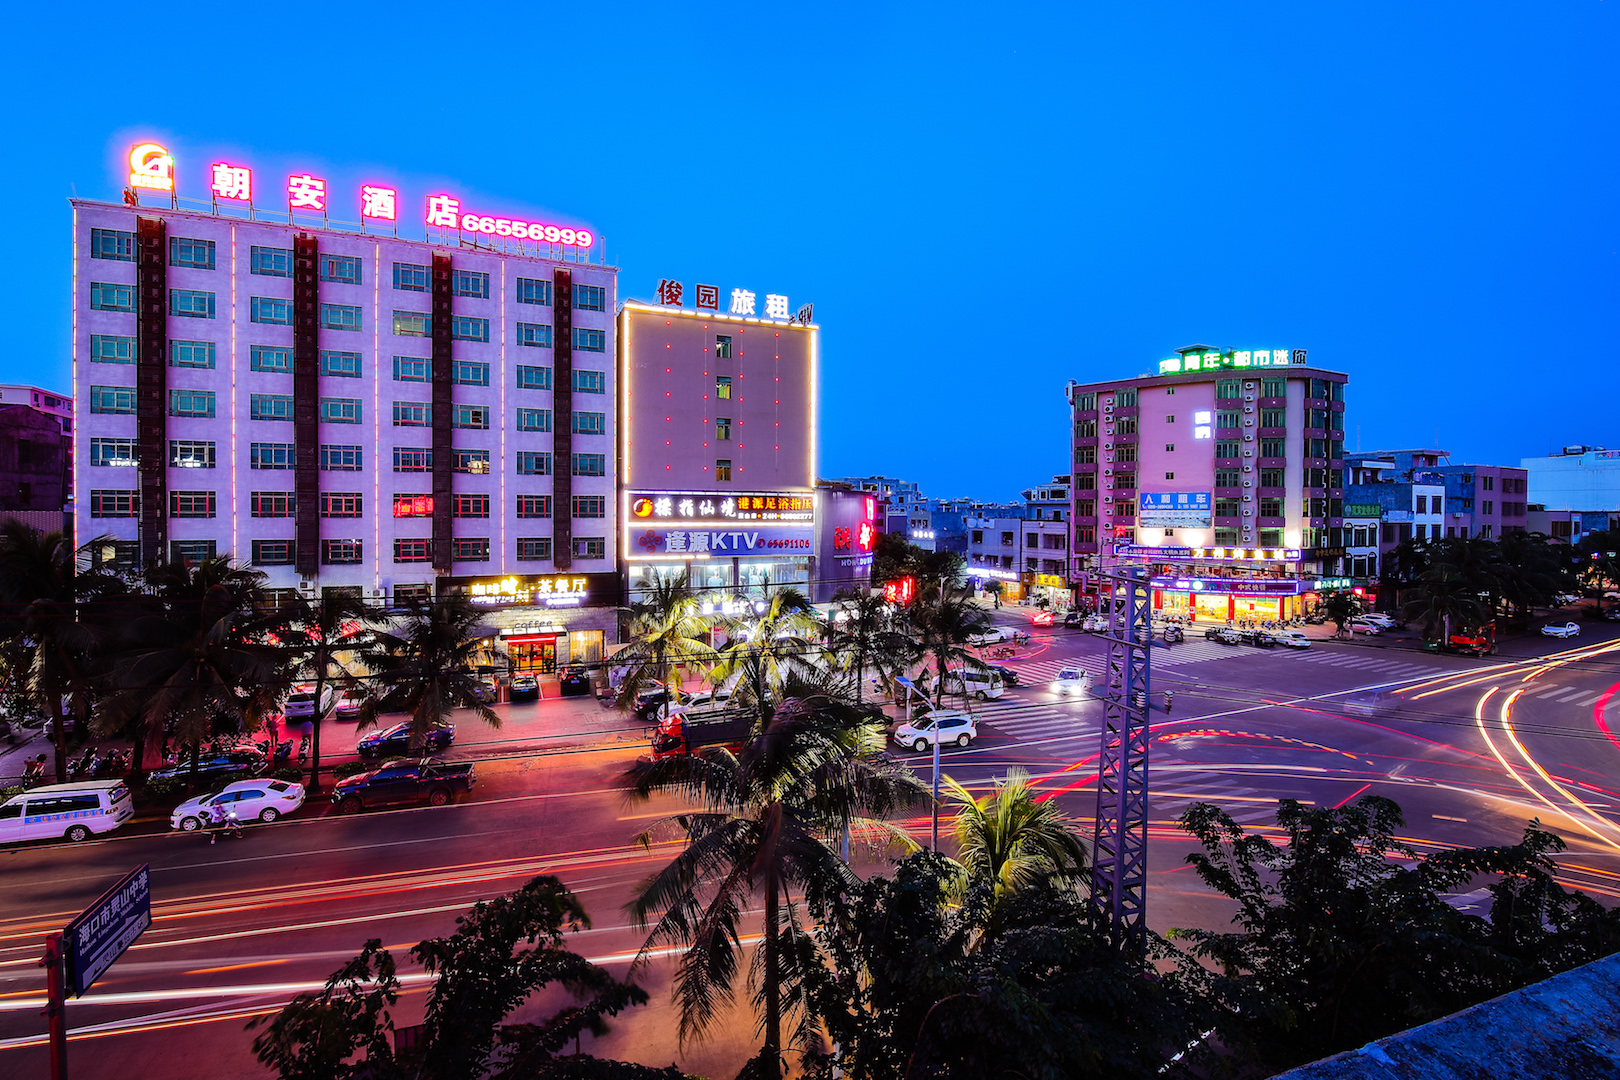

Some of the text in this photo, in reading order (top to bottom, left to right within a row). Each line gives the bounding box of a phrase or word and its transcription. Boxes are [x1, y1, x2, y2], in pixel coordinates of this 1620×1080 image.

[211, 163, 594, 249] 朝安酒店 66556999
[658, 279, 790, 319] 俊园旅租
[767, 538, 810, 549] 65691106
[514, 620, 553, 629] coffee
[79, 870, 148, 947] 海口市灵山中学
